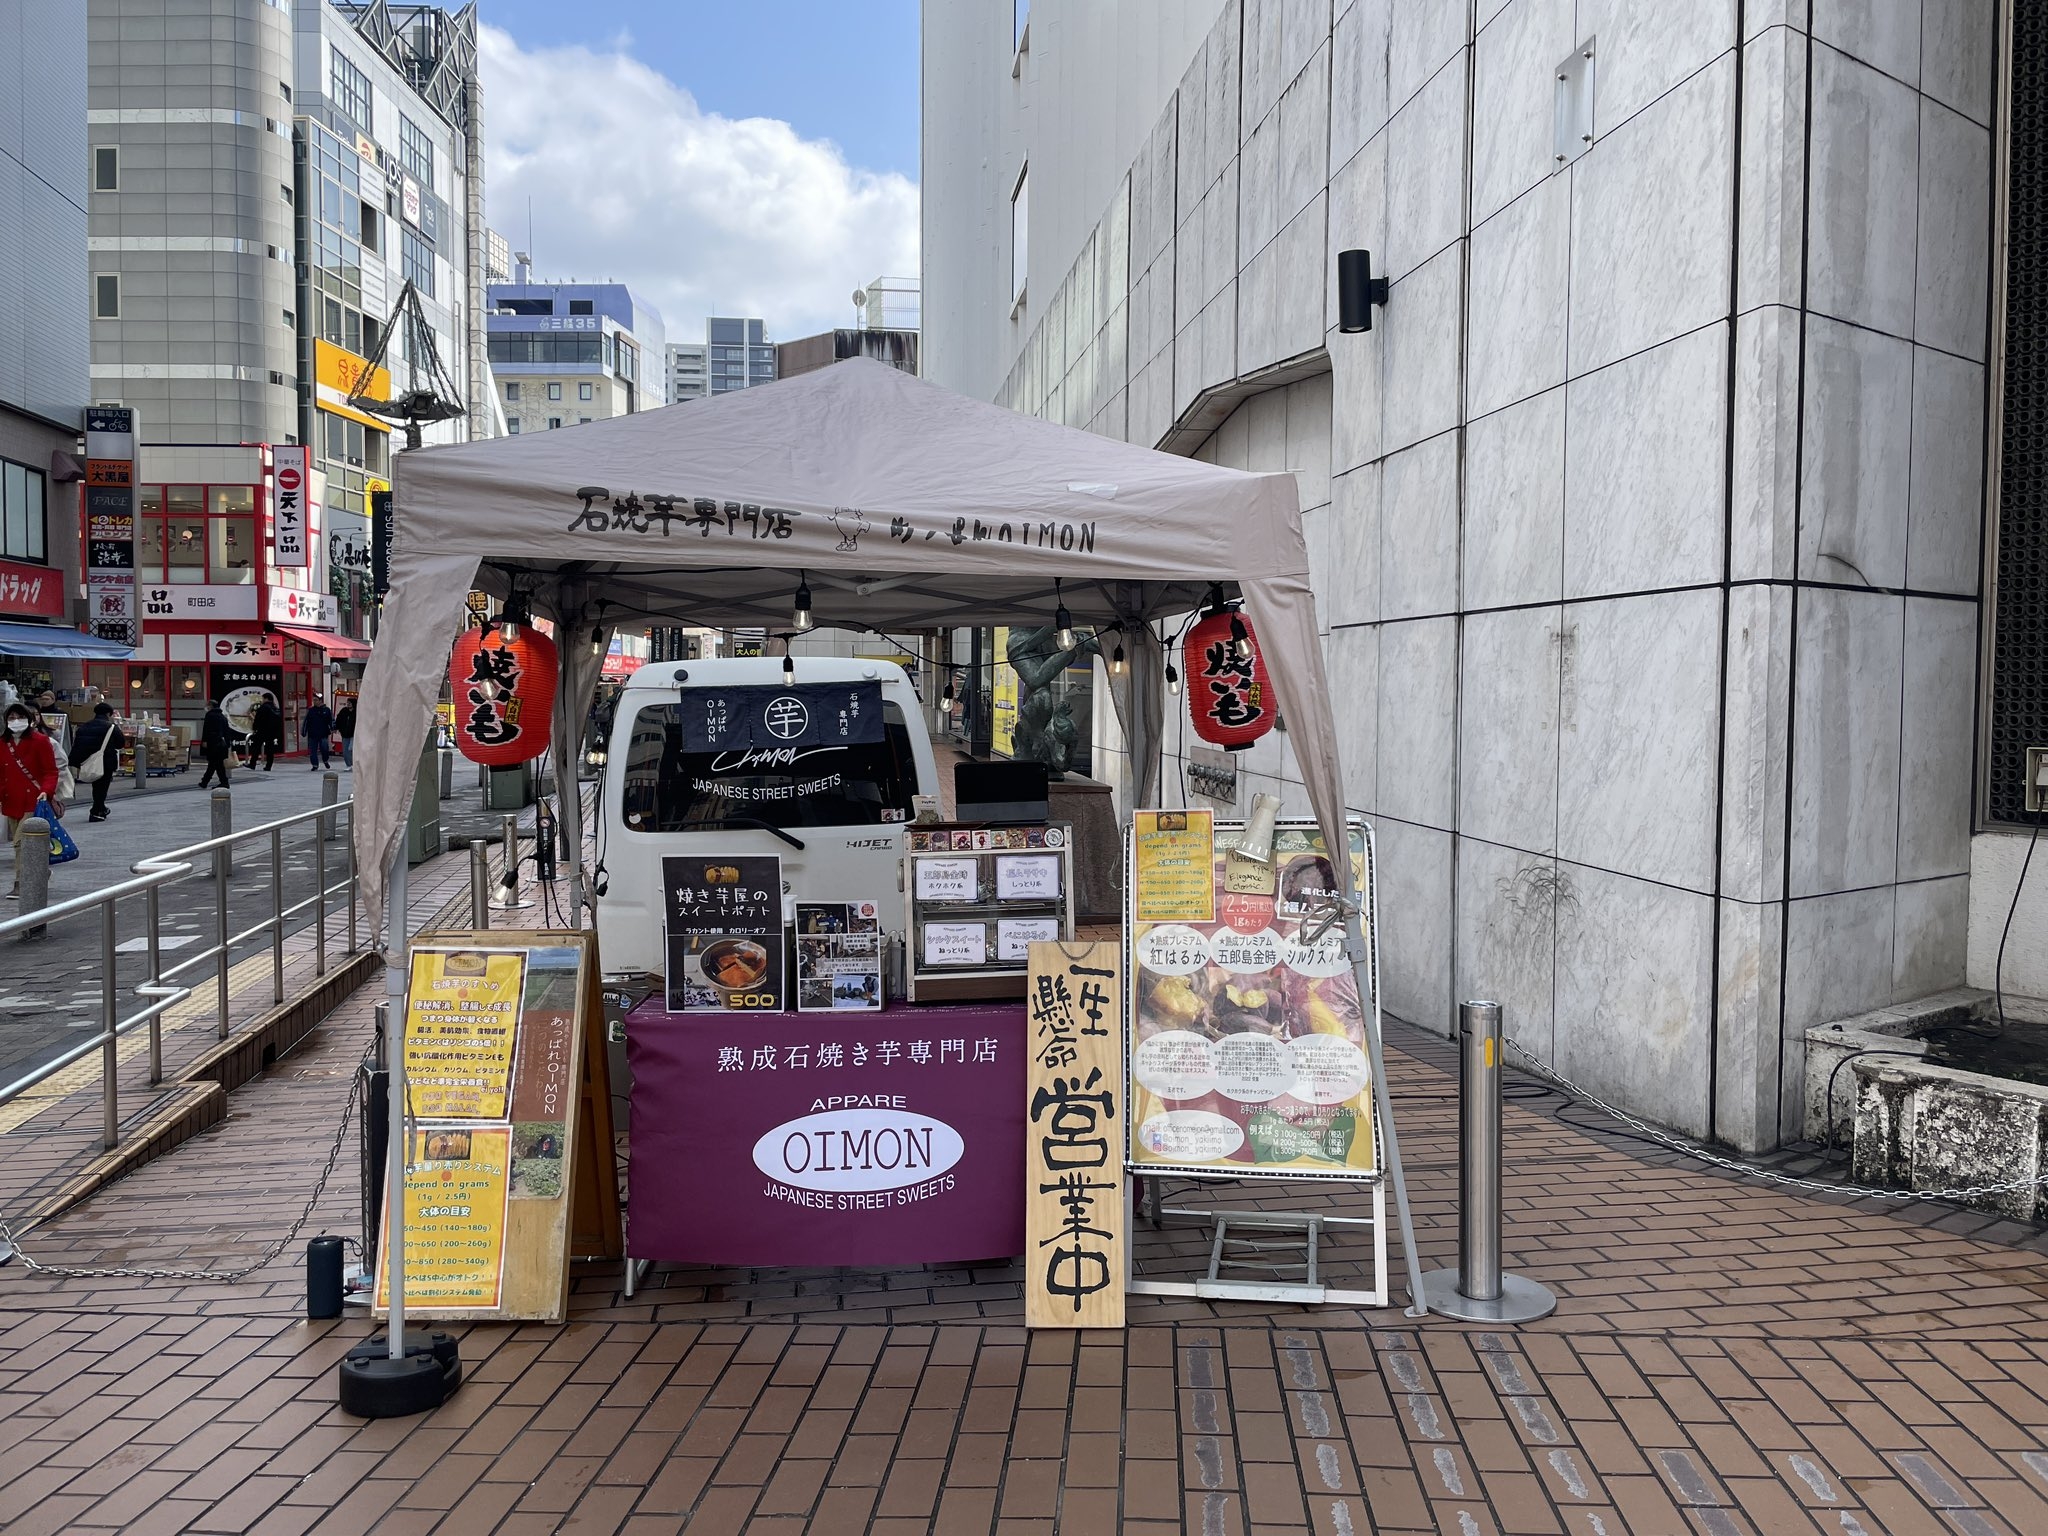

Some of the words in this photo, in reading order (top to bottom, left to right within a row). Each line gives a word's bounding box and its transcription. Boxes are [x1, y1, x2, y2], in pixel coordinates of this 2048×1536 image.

[91, 471, 129, 483] 大黒屋
[279, 491, 301, 554] 天下一品
[567, 487, 802, 541] 石焼芋専門店
[143, 590, 174, 614] 品
[187, 597, 216, 607] 町田店
[234, 641, 281, 657] 天下一品
[1201, 639, 1265, 728] 焼いも
[464, 645, 525, 747] 焼いも
[849, 692, 859, 718] 石焼芋
[706, 700, 717, 743] OIMON
[717, 699, 728, 732] あっぱれ
[838, 709, 849, 735] 専門店
[692, 777, 750, 799] JAPANESE
[752, 785, 794, 800] STREET
[797, 773, 842, 797] SWEETS
[846, 838, 892, 849] HIJET
[675, 887, 768, 905] 焼き芋屋の
[1301, 887, 1340, 898] 進化した
[677, 906, 771, 917] スイートポテト
[1149, 949, 1206, 966] 紅はるか
[1218, 949, 1277, 966] 五郎島金時
[729, 994, 775, 1007] 500
[717, 1037, 999, 1073] 熟成石焼き芋専門店
[810, 1094, 907, 1112] APPARE
[1249, 1124, 1273, 1135] 例えば
[783, 1127, 933, 1174] OIMON
[459, 1181, 489, 1190] grams
[763, 1181, 834, 1210] JAPANESE
[838, 1192, 893, 1210] STREET
[897, 1174, 955, 1205] SWEETS
[1030, 1066, 1117, 1313] 営業中
[419, 1206, 471, 1217] 大体の目安
